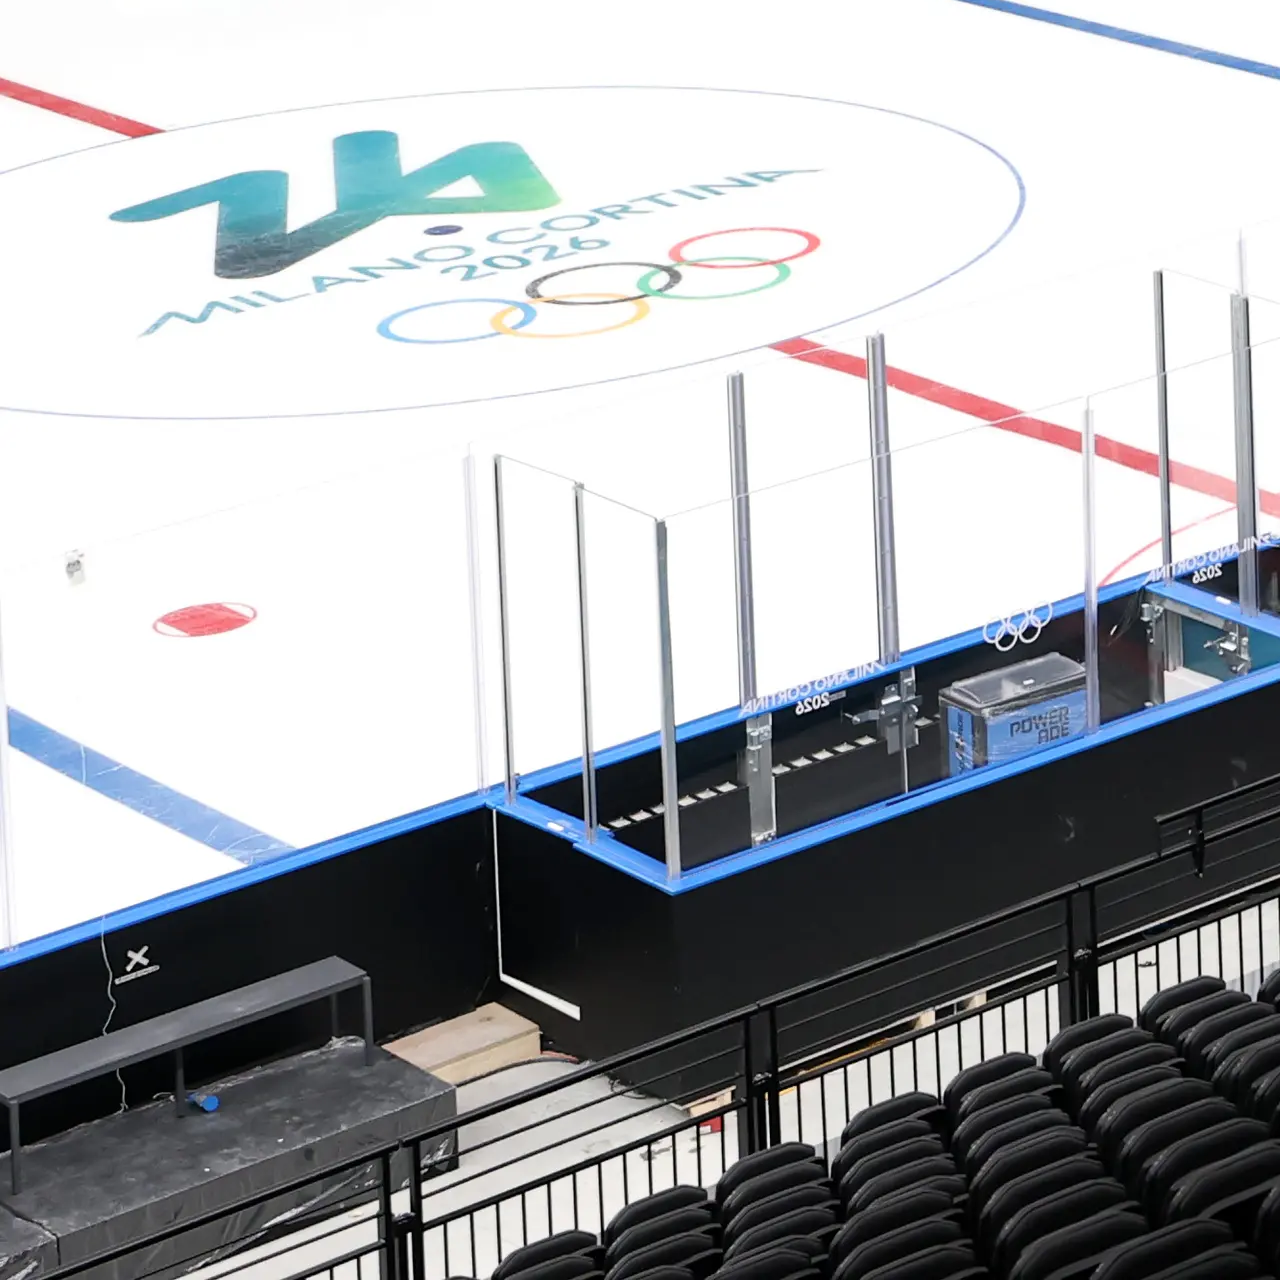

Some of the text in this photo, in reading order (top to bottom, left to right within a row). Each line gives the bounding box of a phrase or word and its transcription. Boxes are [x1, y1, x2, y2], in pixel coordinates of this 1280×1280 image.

[135, 167, 826, 339] MILANO CORTINA
[440, 235, 612, 282] 2026
[1009, 705, 1070, 738] POWER
[1037, 723, 1071, 745] ADE
